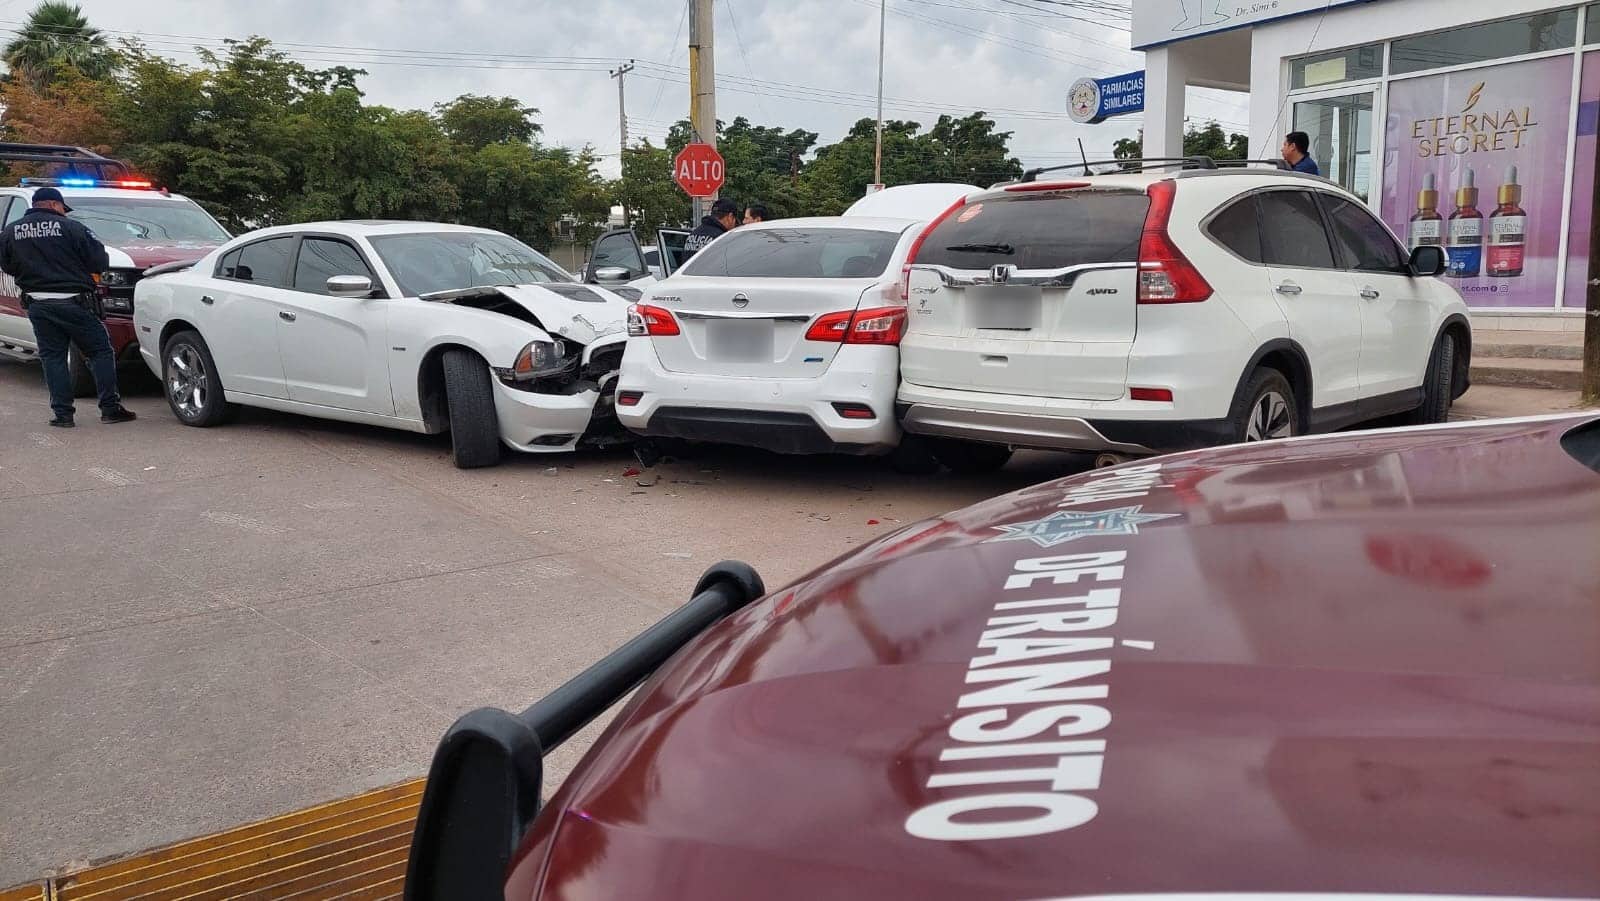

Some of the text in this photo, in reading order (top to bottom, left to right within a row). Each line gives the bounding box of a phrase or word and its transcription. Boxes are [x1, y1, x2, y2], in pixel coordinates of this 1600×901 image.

[1101, 78, 1144, 97] FARMACIAS
[1103, 92, 1142, 110] SIMILARES
[1411, 106, 1538, 139] ETERNAL
[1418, 128, 1528, 158] SECRET
[679, 159, 722, 181] ALTO
[14, 228, 63, 241] MUNICIPAL
[1085, 288, 1118, 296] 4WD
[1003, 550, 1127, 590] DE
[904, 587, 1155, 841] TRÁNSITO
